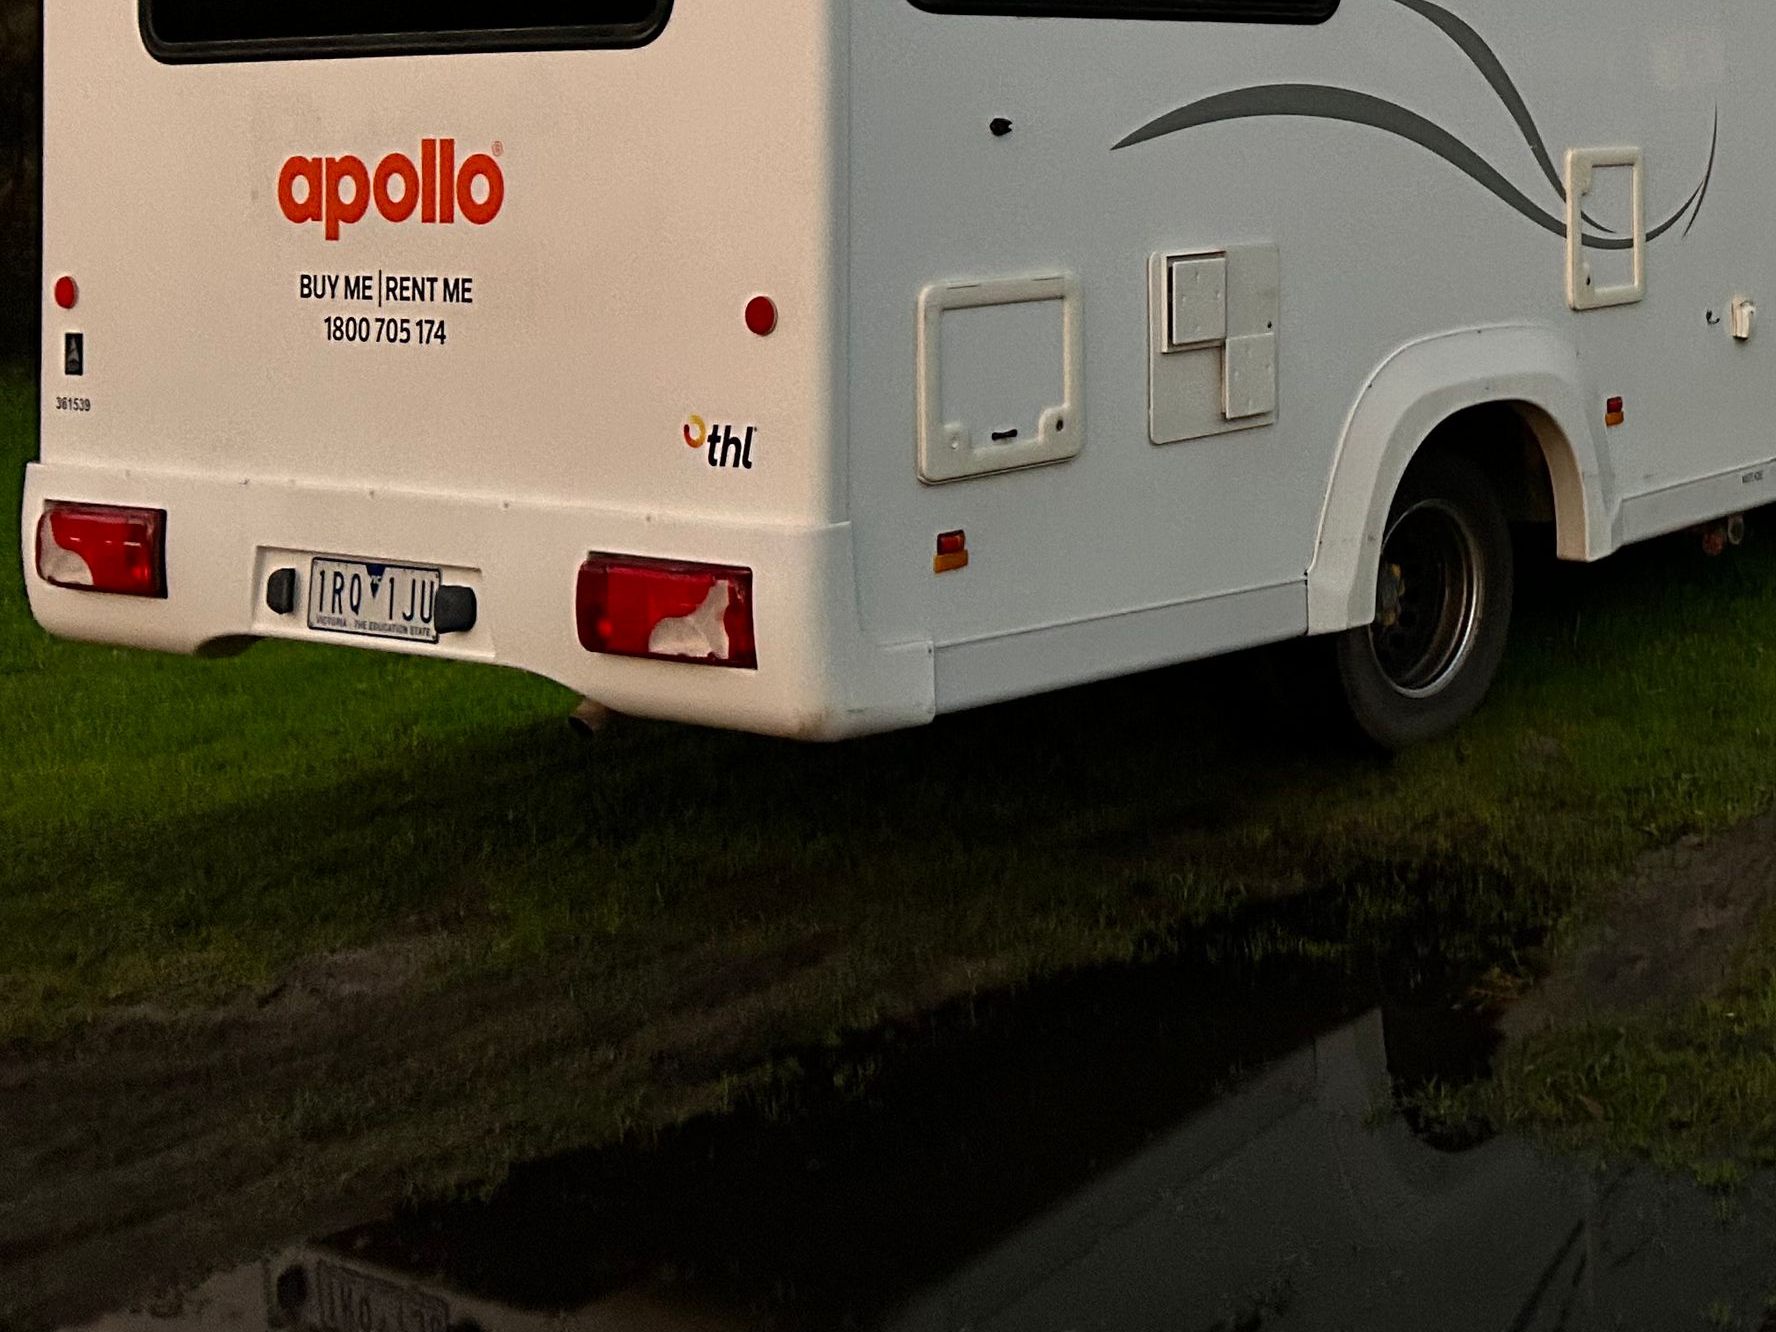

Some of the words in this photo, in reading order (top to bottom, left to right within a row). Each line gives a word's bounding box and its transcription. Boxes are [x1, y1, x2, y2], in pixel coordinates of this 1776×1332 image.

[278, 138, 505, 241] apollo
[300, 274, 339, 299] BUY
[344, 276, 373, 300] ME
[386, 276, 438, 302] RENT
[443, 278, 473, 303] ME
[324, 316, 370, 343] 1800
[375, 318, 411, 344] 705
[416, 319, 446, 345] 174
[707, 424, 754, 469] thl
